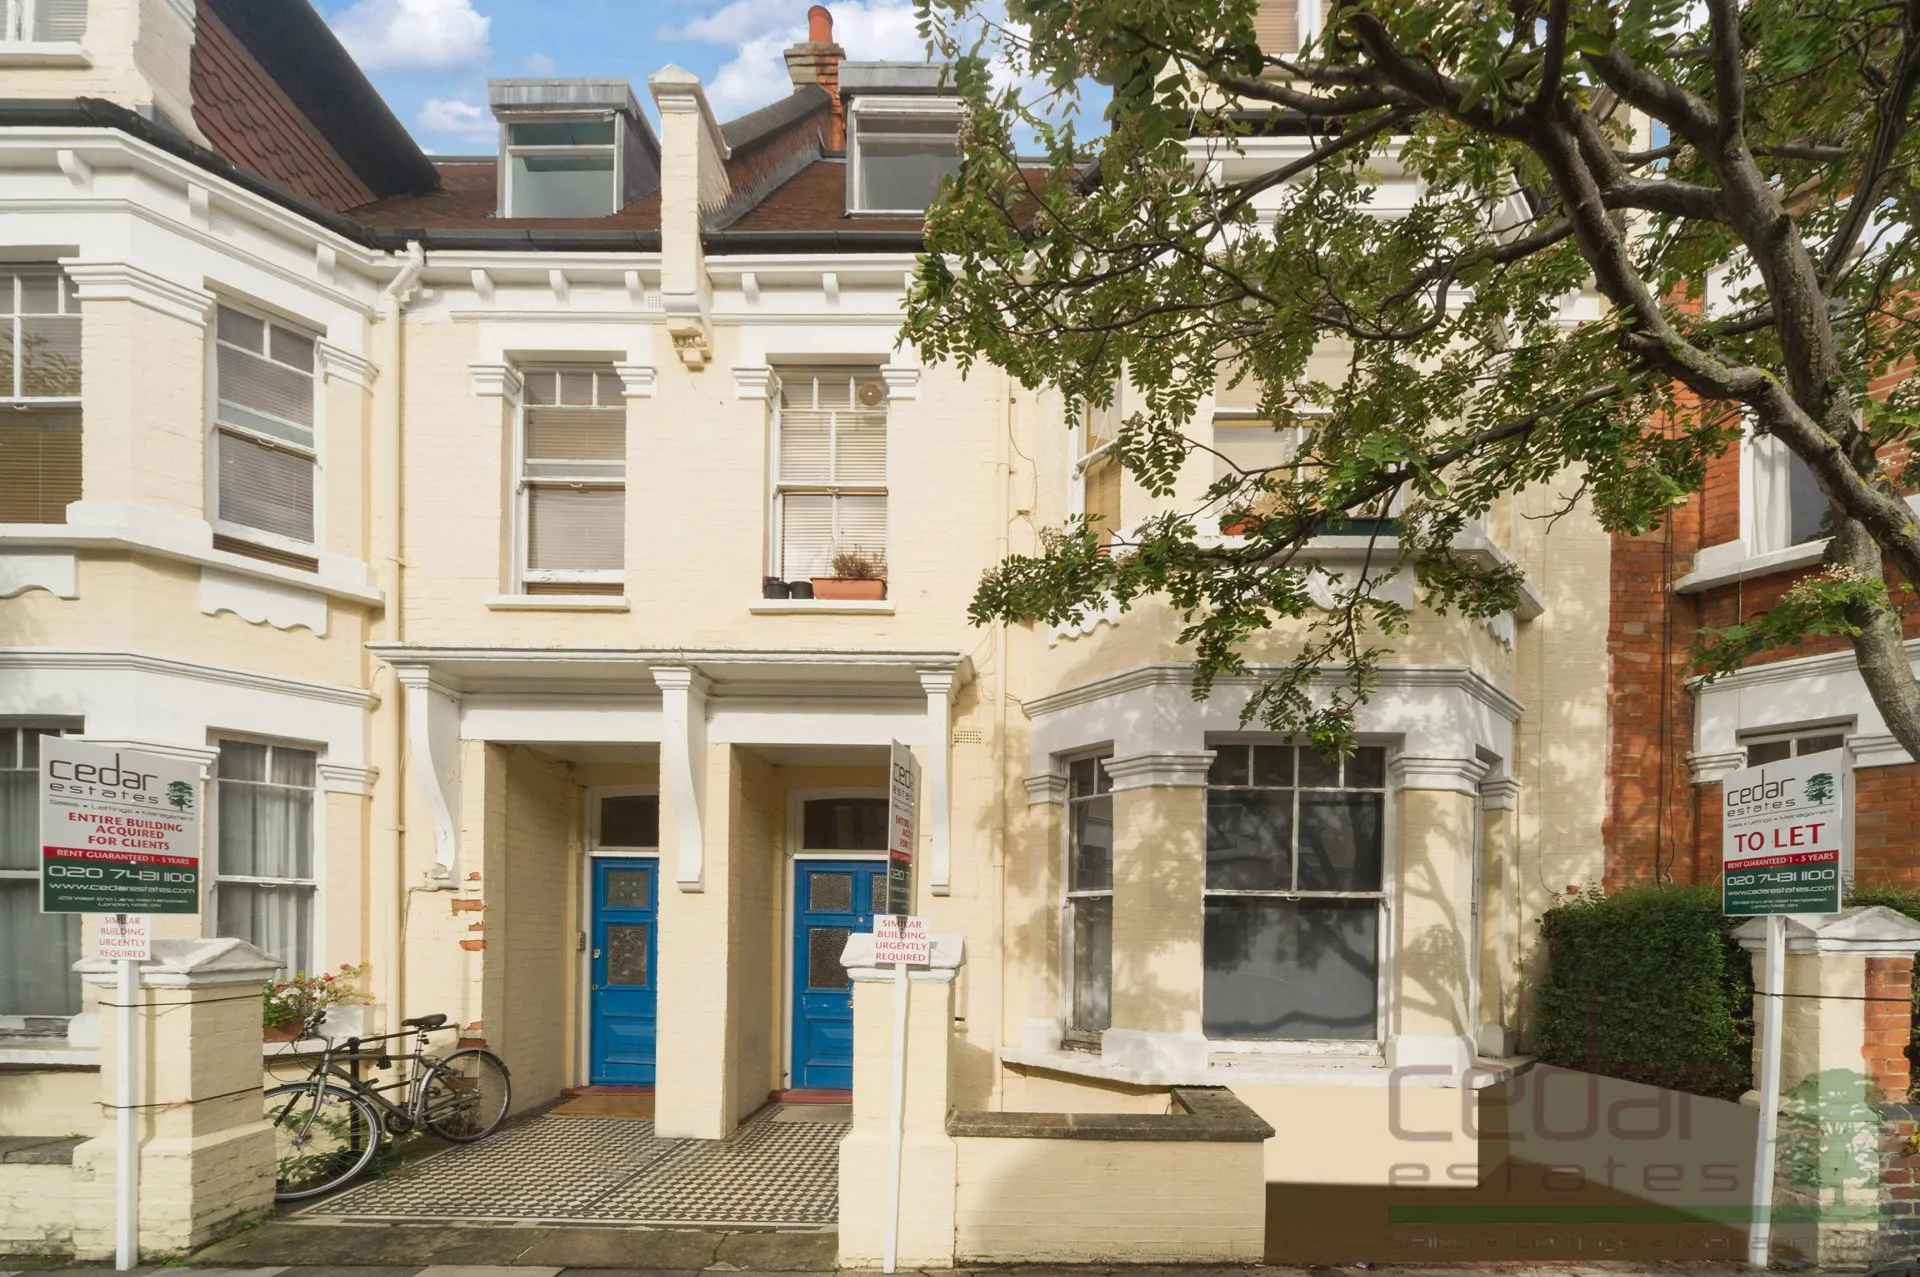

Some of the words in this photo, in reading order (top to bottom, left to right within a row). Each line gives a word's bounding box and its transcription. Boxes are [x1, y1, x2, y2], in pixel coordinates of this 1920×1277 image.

[50, 753, 158, 791] cedar
[50, 782, 159, 804] estates
[1727, 769, 1795, 807] cedar
[1727, 799, 1796, 817] estates
[68, 812, 122, 826] ENTIRE
[126, 818, 183, 833] BUILDING
[95, 825, 165, 839] ACQUIRED
[1734, 831, 1765, 853] TO
[1774, 823, 1825, 849] LET
[88, 835, 117, 846] FOR
[122, 838, 170, 850] CLIENTS
[56, 849, 83, 858] RENT
[86, 851, 149, 862] GUARANTEED
[167, 857, 190, 865] YEARS
[1727, 861, 1743, 869] RENT
[1743, 858, 1787, 868] GUARANTEED
[1808, 852, 1834, 861] YEARS
[48, 865, 104, 879] 020
[109, 869, 160, 882] 7431
[164, 872, 195, 883] 1100
[1727, 875, 1754, 886] 020
[1758, 872, 1797, 884] 7431
[1801, 869, 1835, 881] 1100
[49, 882, 195, 894] www.cedarestates.com
[1727, 885, 1835, 896] www.cedarestates.com
[104, 916, 141, 924] SIMILAR
[882, 920, 922, 928] SIMILAR
[101, 928, 145, 936] BUILDING
[877, 930, 926, 940] BUILDING
[875, 941, 927, 950] URGENTLY
[100, 949, 145, 958] REQUIRED
[875, 952, 926, 961] REQUIRED
